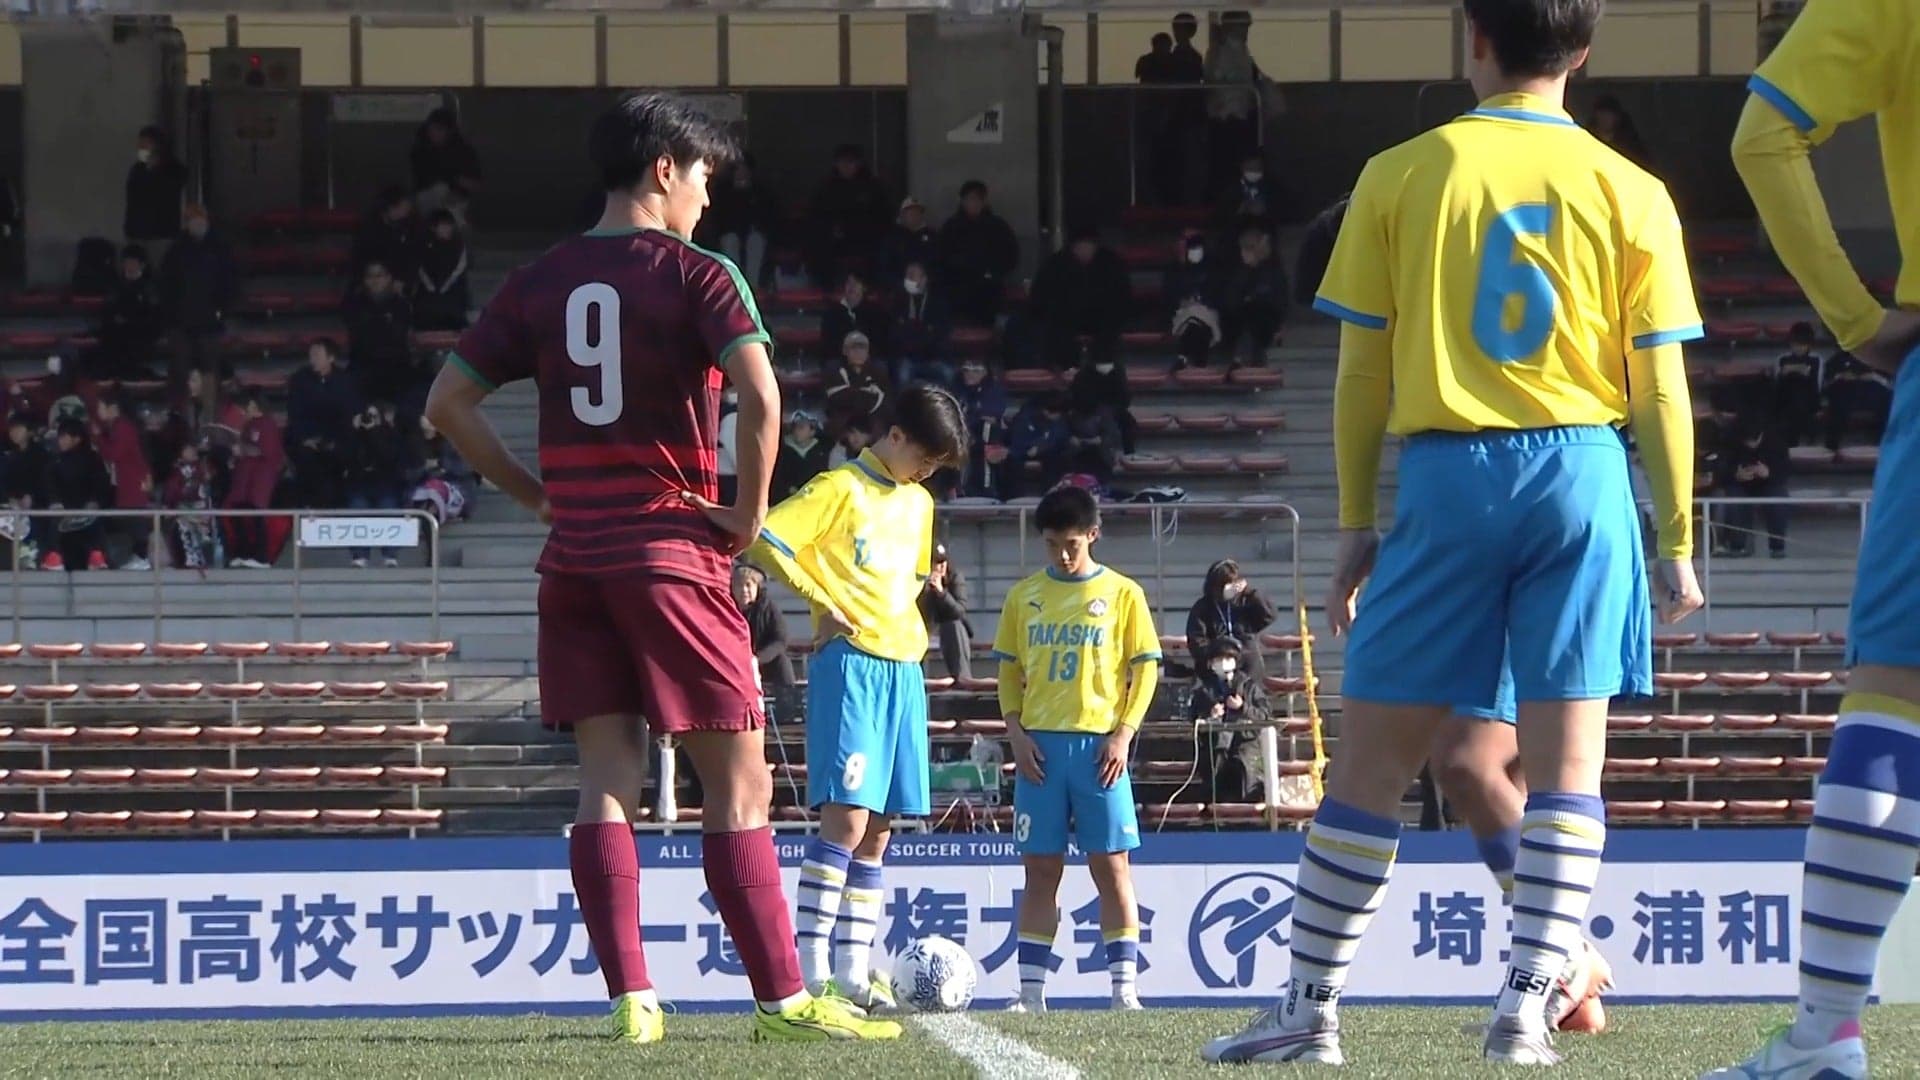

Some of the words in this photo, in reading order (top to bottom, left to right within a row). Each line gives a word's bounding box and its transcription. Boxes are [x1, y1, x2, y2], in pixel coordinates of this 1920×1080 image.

[1472, 203, 1555, 363] 6
[566, 282, 623, 426] 9
[1048, 652, 1078, 682] 13
[843, 753, 867, 790] 8
[659, 846, 692, 858] ALL
[890, 843, 962, 857] SOCCER
[1412, 889, 1791, 966] 埼・浦和
